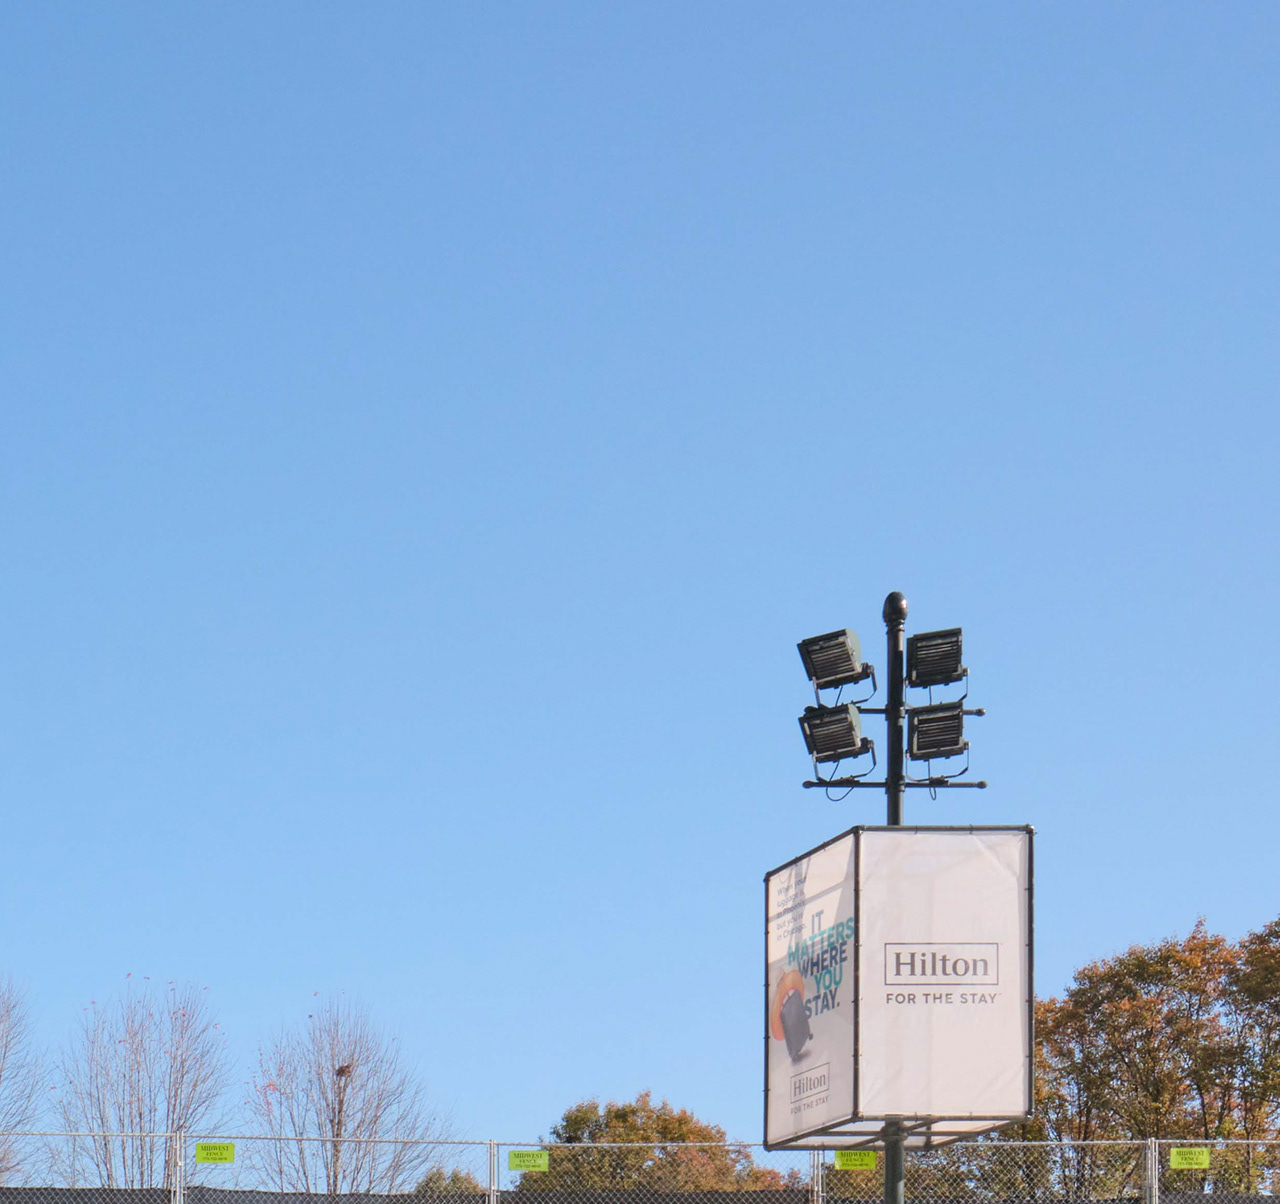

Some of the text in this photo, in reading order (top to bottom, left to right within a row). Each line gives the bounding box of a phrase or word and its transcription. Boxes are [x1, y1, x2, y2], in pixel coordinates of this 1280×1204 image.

[811, 909, 824, 936] IT
[788, 916, 855, 966] MATTERS
[798, 941, 848, 979] WHERE
[894, 952, 989, 976] Hilton
[814, 963, 843, 994] YOU
[804, 986, 840, 1020] STAY.
[886, 993, 997, 1005] FOR THE STAY
[794, 1074, 826, 1097] Hilton
